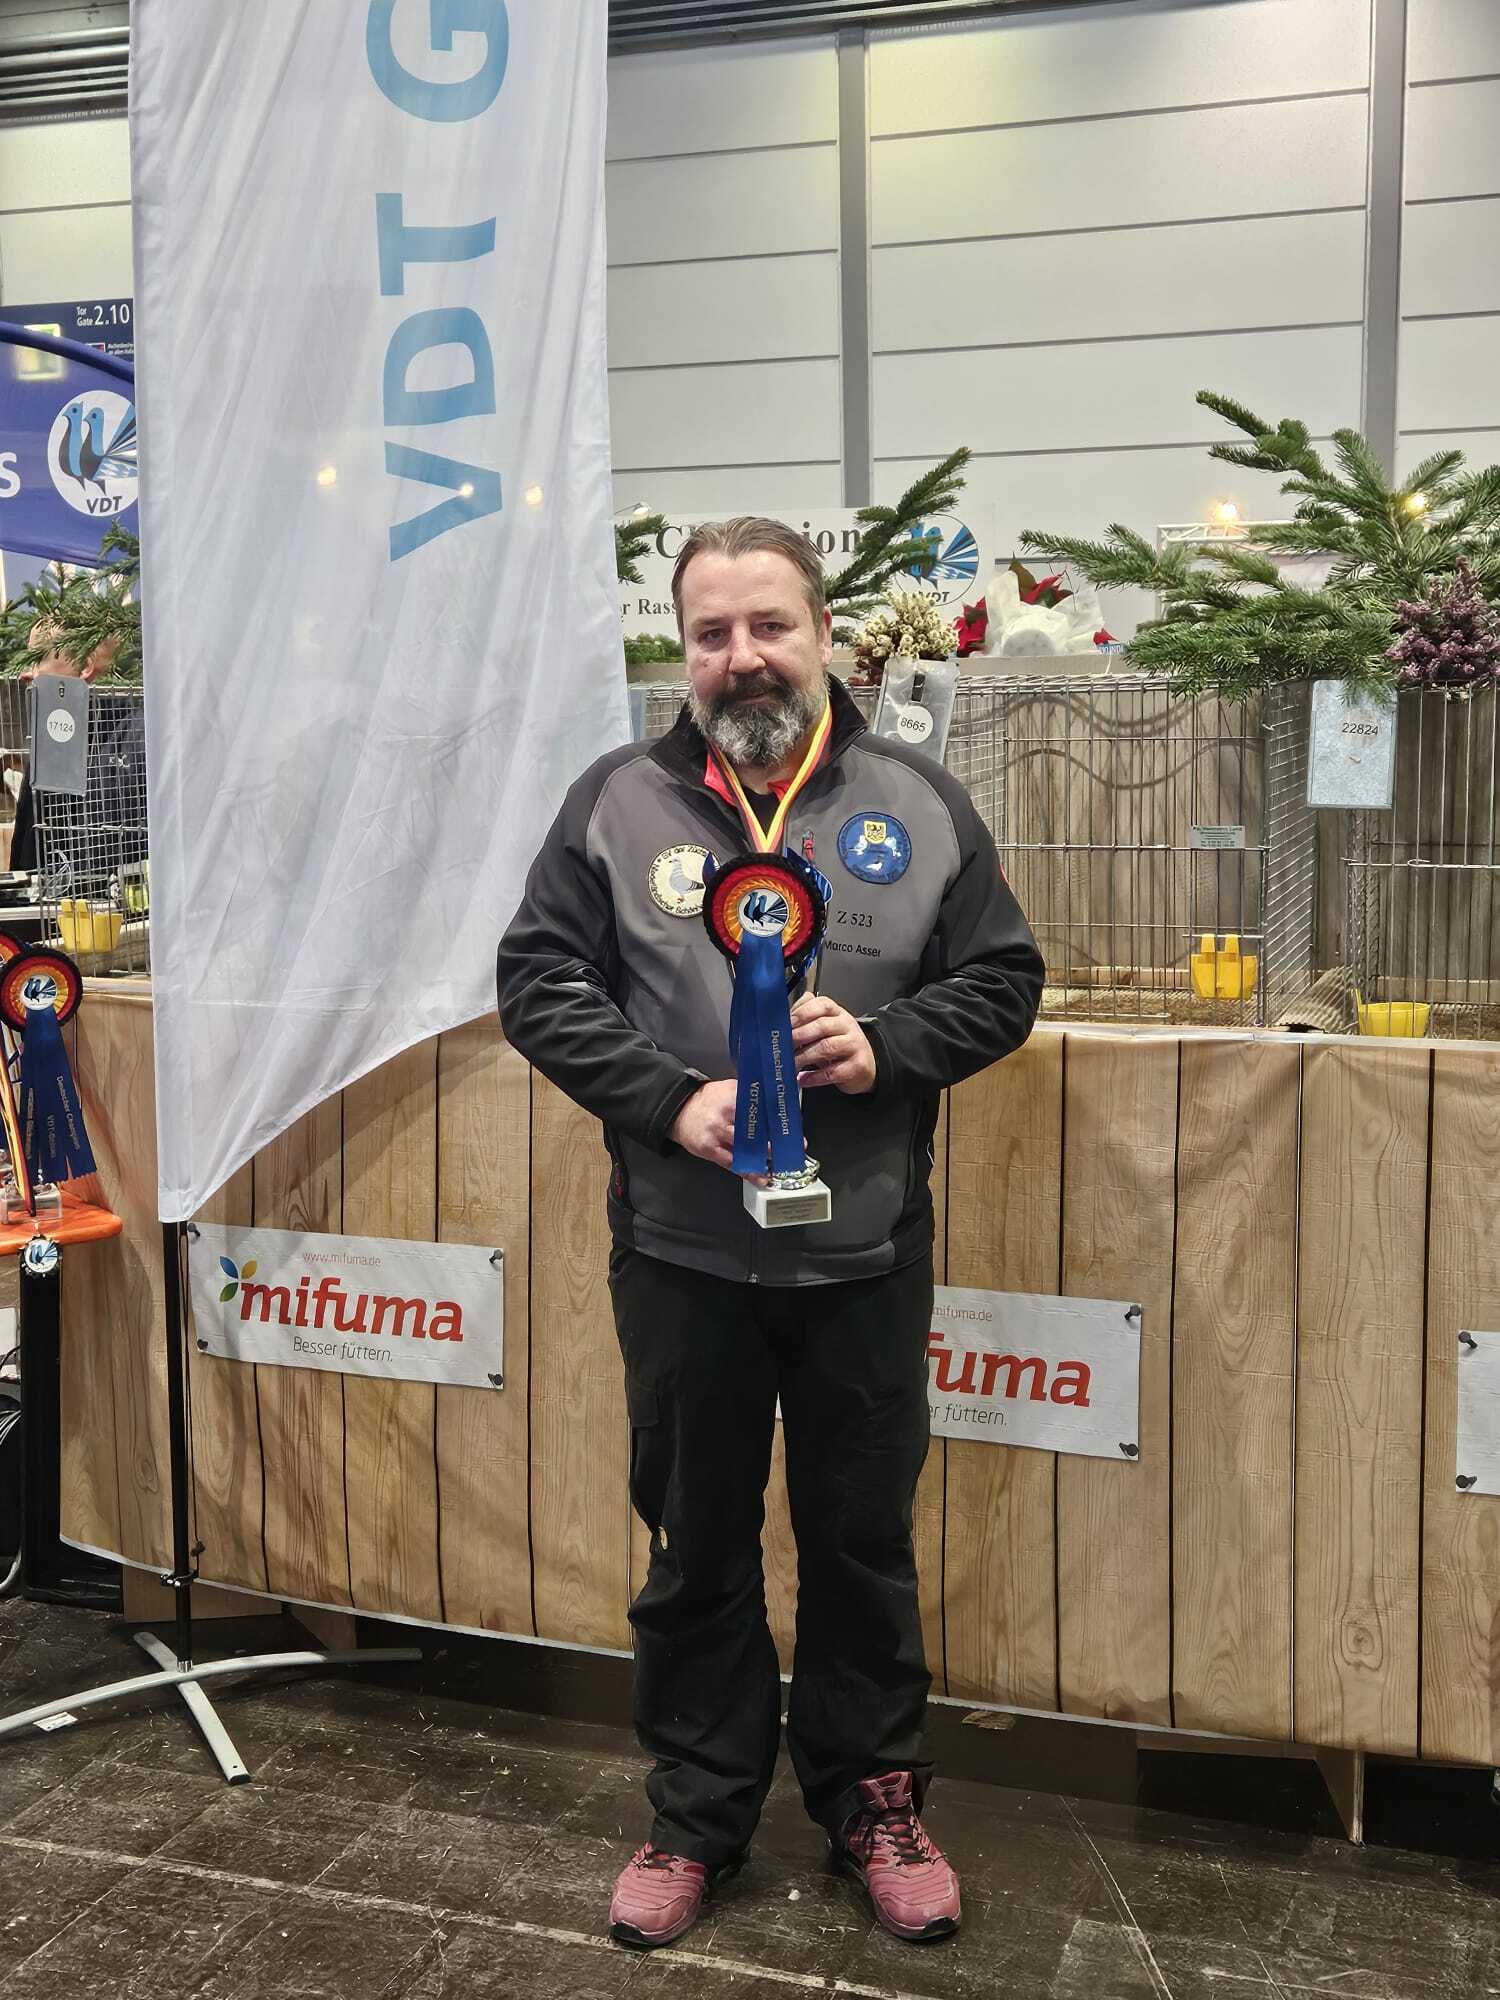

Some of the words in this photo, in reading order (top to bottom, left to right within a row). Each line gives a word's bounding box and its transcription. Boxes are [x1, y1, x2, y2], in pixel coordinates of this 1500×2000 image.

[77, 317, 93, 327] Gate
[376, 192, 503, 562] VDT
[86, 496, 122, 513] VDT
[49, 721, 73, 732] 17124
[900, 717, 927, 733] 8665
[1341, 722, 1379, 735] 22824
[837, 910, 848, 924] Z
[850, 912, 873, 928] 523
[824, 940, 854, 953] Marco
[855, 944, 882, 957] Asser
[771, 1030, 784, 1081] Deutscher
[776, 1084, 790, 1135] Champion
[302, 1250, 383, 1267] www.mifuma.de
[240, 1276, 464, 1342] mifuma
[293, 1336, 338, 1356] Besser
[340, 1341, 394, 1363] füttern.
[944, 1402, 1008, 1427] füttern.
